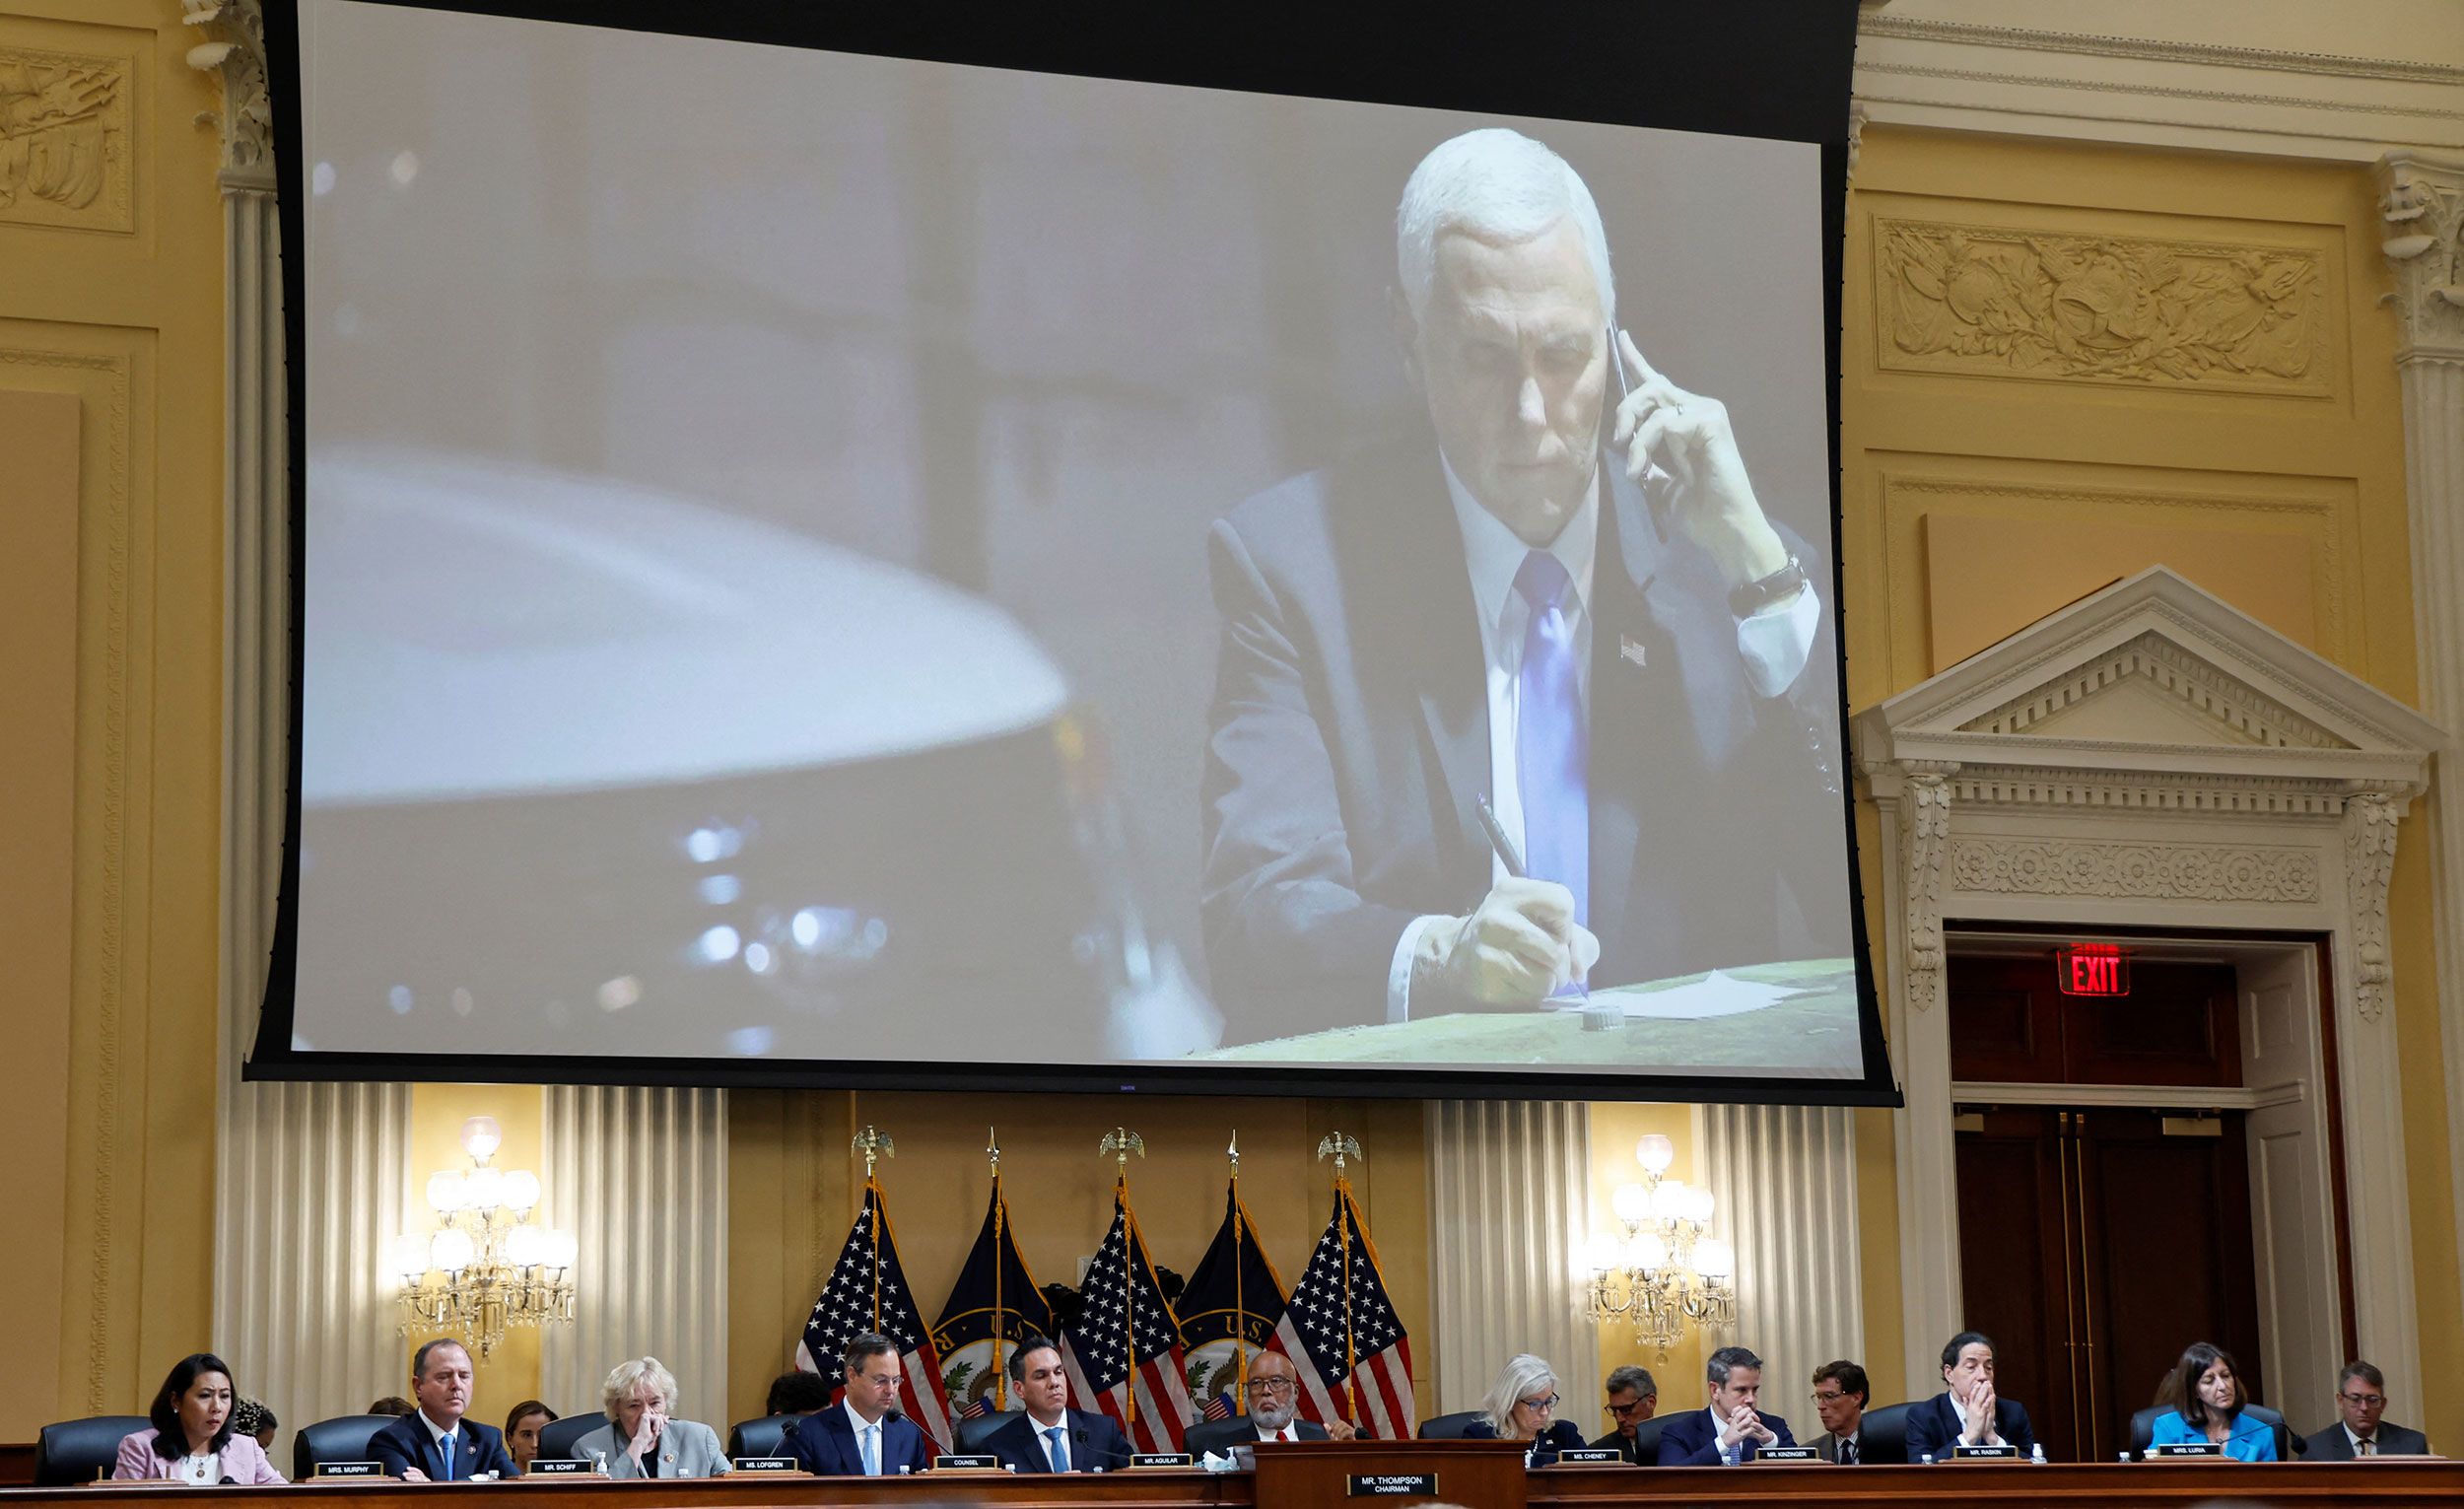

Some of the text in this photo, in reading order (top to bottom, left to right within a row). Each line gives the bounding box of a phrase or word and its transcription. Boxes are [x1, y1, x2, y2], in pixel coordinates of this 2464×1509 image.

[2072, 956, 2120, 993] EXIT
[328, 1466, 342, 1475] MRS.
[1361, 1475, 1422, 1485] MR. THOMPSON
